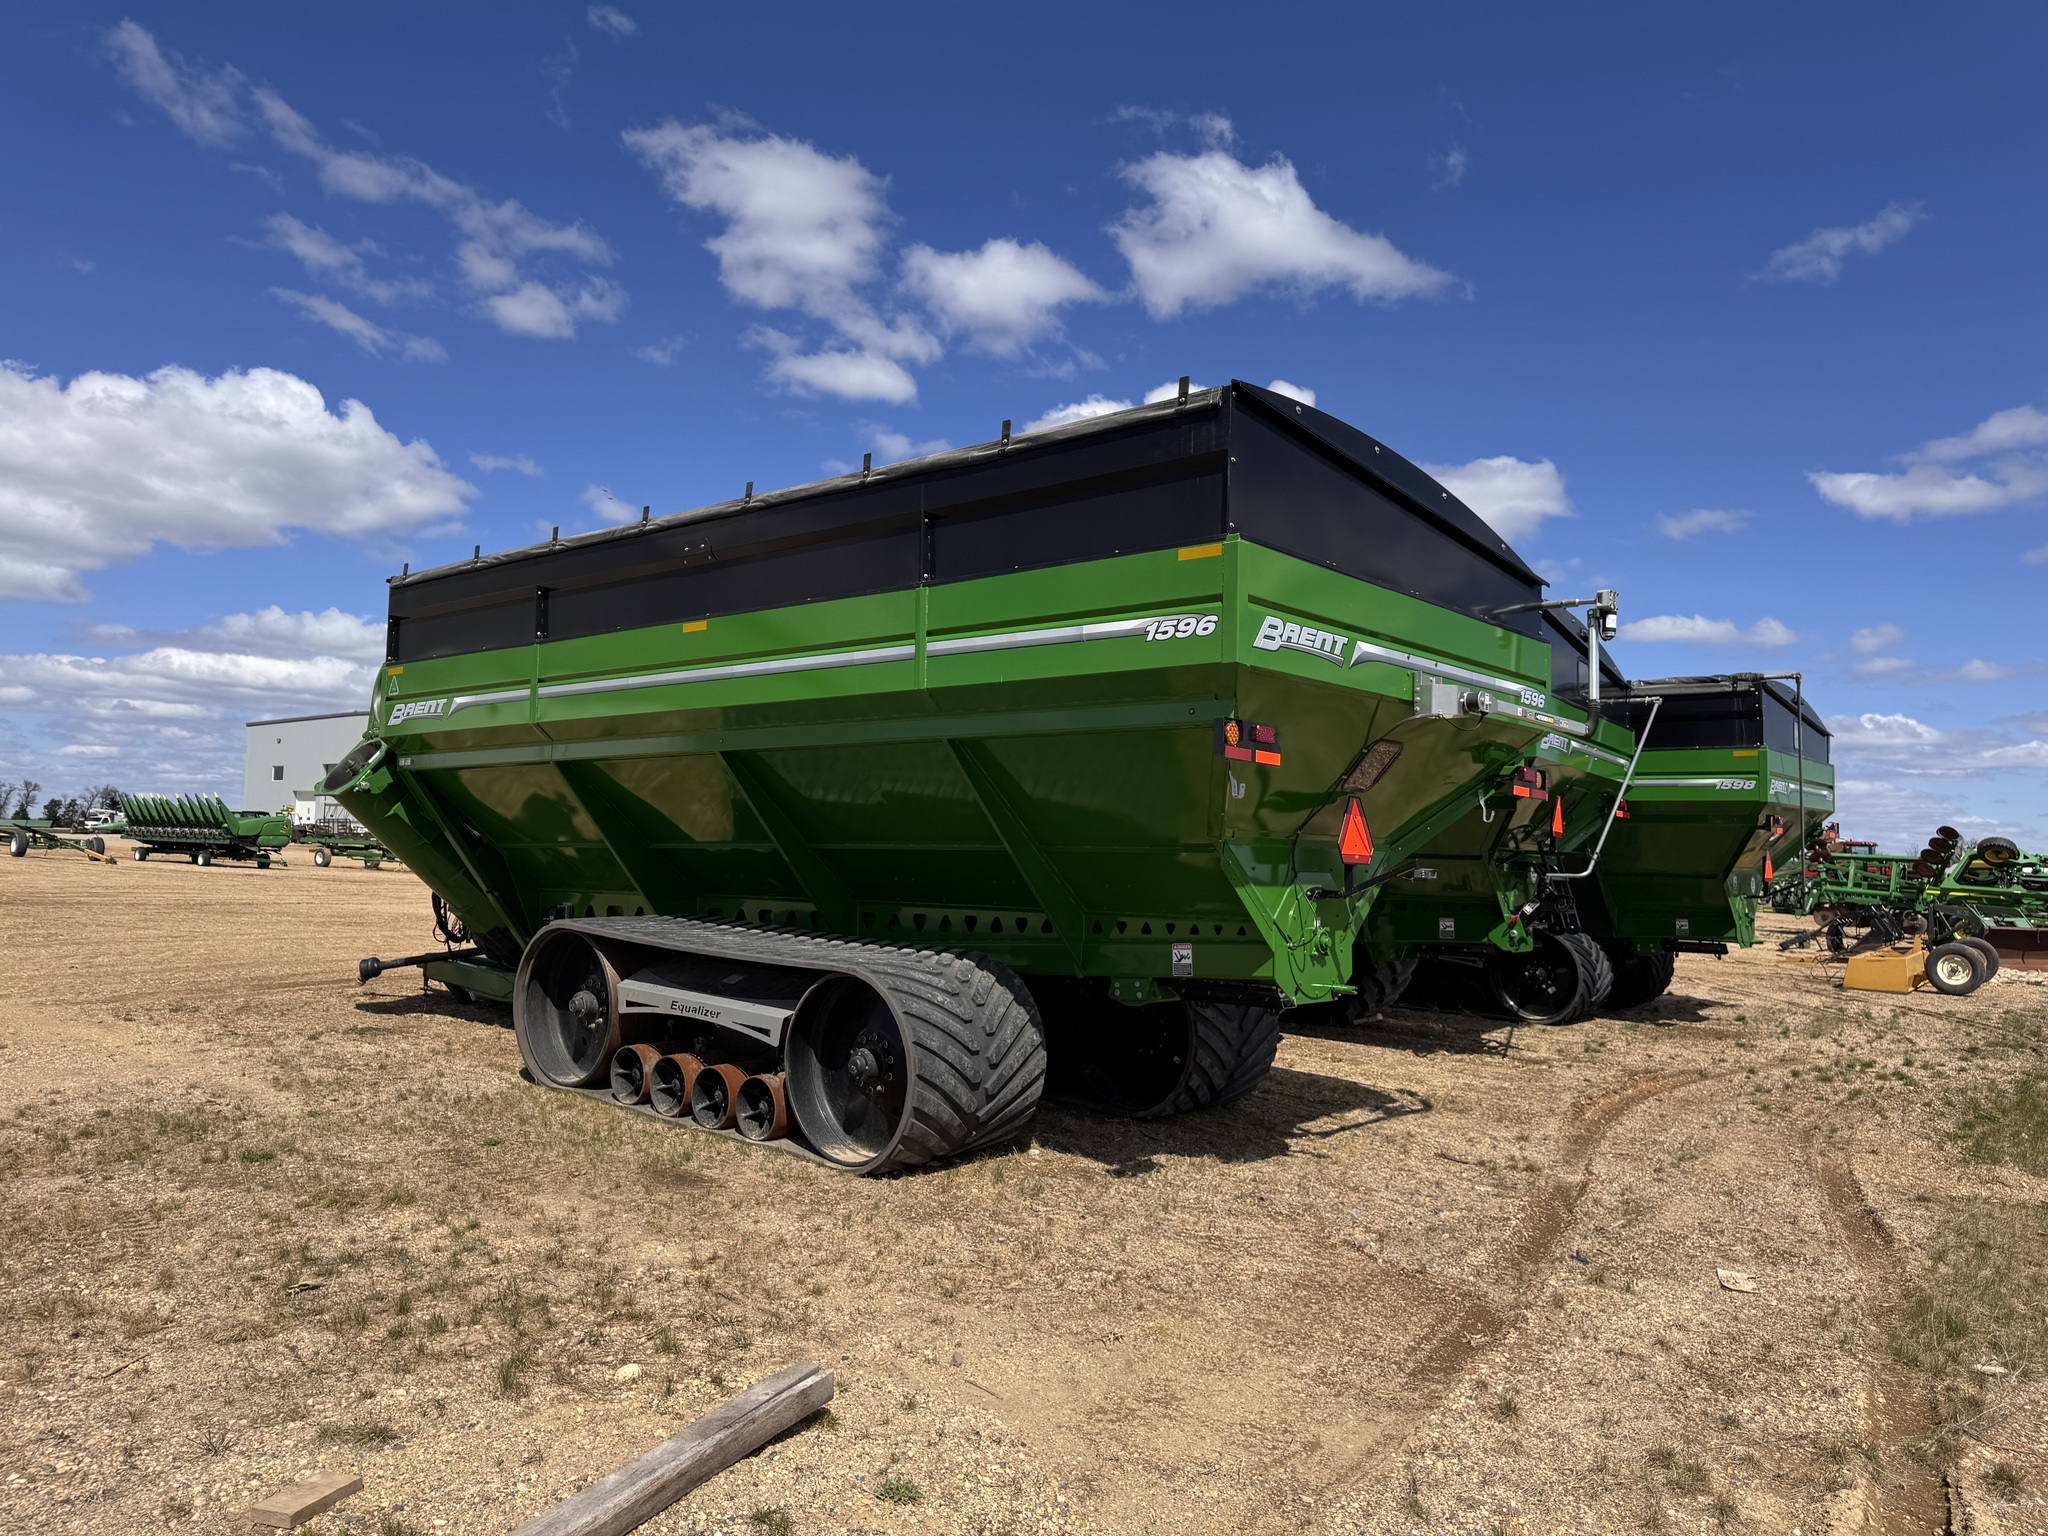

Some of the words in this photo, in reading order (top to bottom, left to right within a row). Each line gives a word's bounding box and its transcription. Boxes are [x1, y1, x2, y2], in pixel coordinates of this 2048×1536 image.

[1145, 615, 1219, 642] 1596
[1253, 615, 1348, 656] BRENT
[1520, 689, 1546, 709] 1596
[387, 698, 448, 726] BRENT
[1715, 780, 1757, 790] 1598
[670, 1000, 721, 1019] Equalizer
